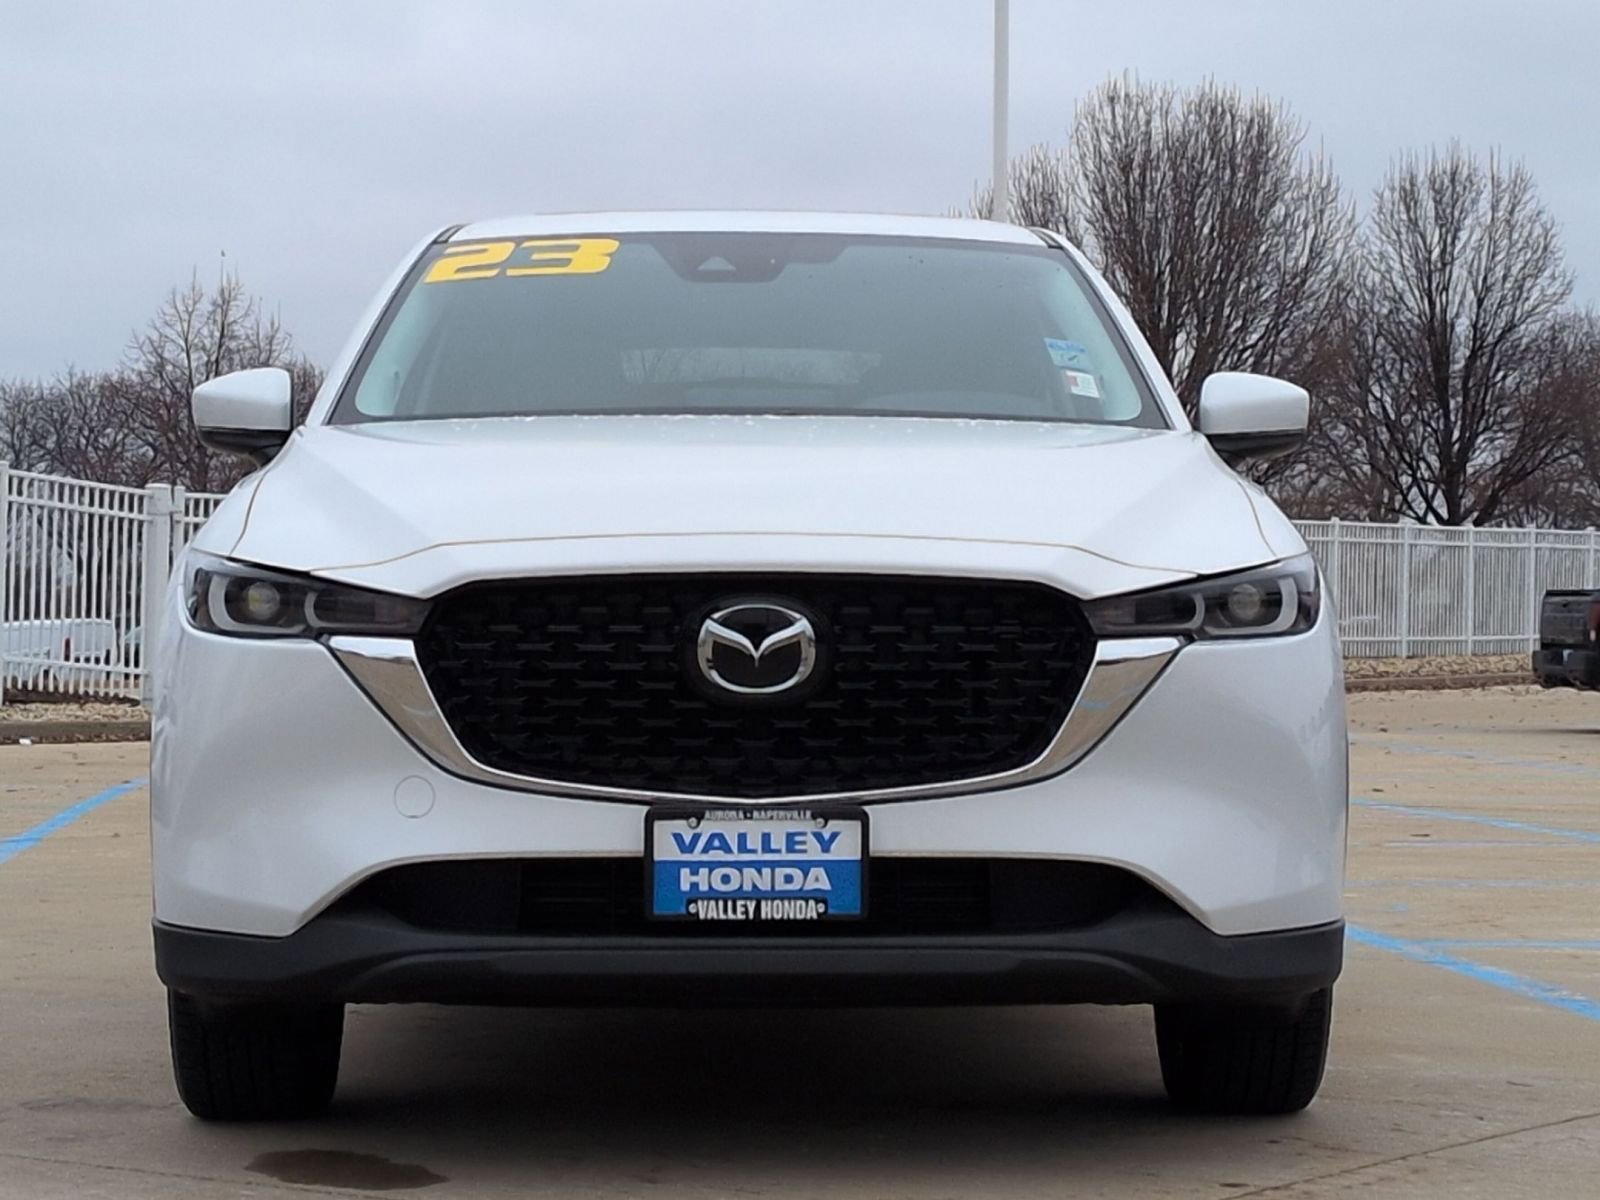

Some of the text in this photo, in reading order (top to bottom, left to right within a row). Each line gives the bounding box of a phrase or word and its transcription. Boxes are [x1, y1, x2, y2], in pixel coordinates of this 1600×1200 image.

[424, 238, 620, 283] 23
[671, 832, 841, 854] VALLEY
[679, 868, 832, 891] HONDA
[698, 900, 818, 920] VALLEY HONDA
